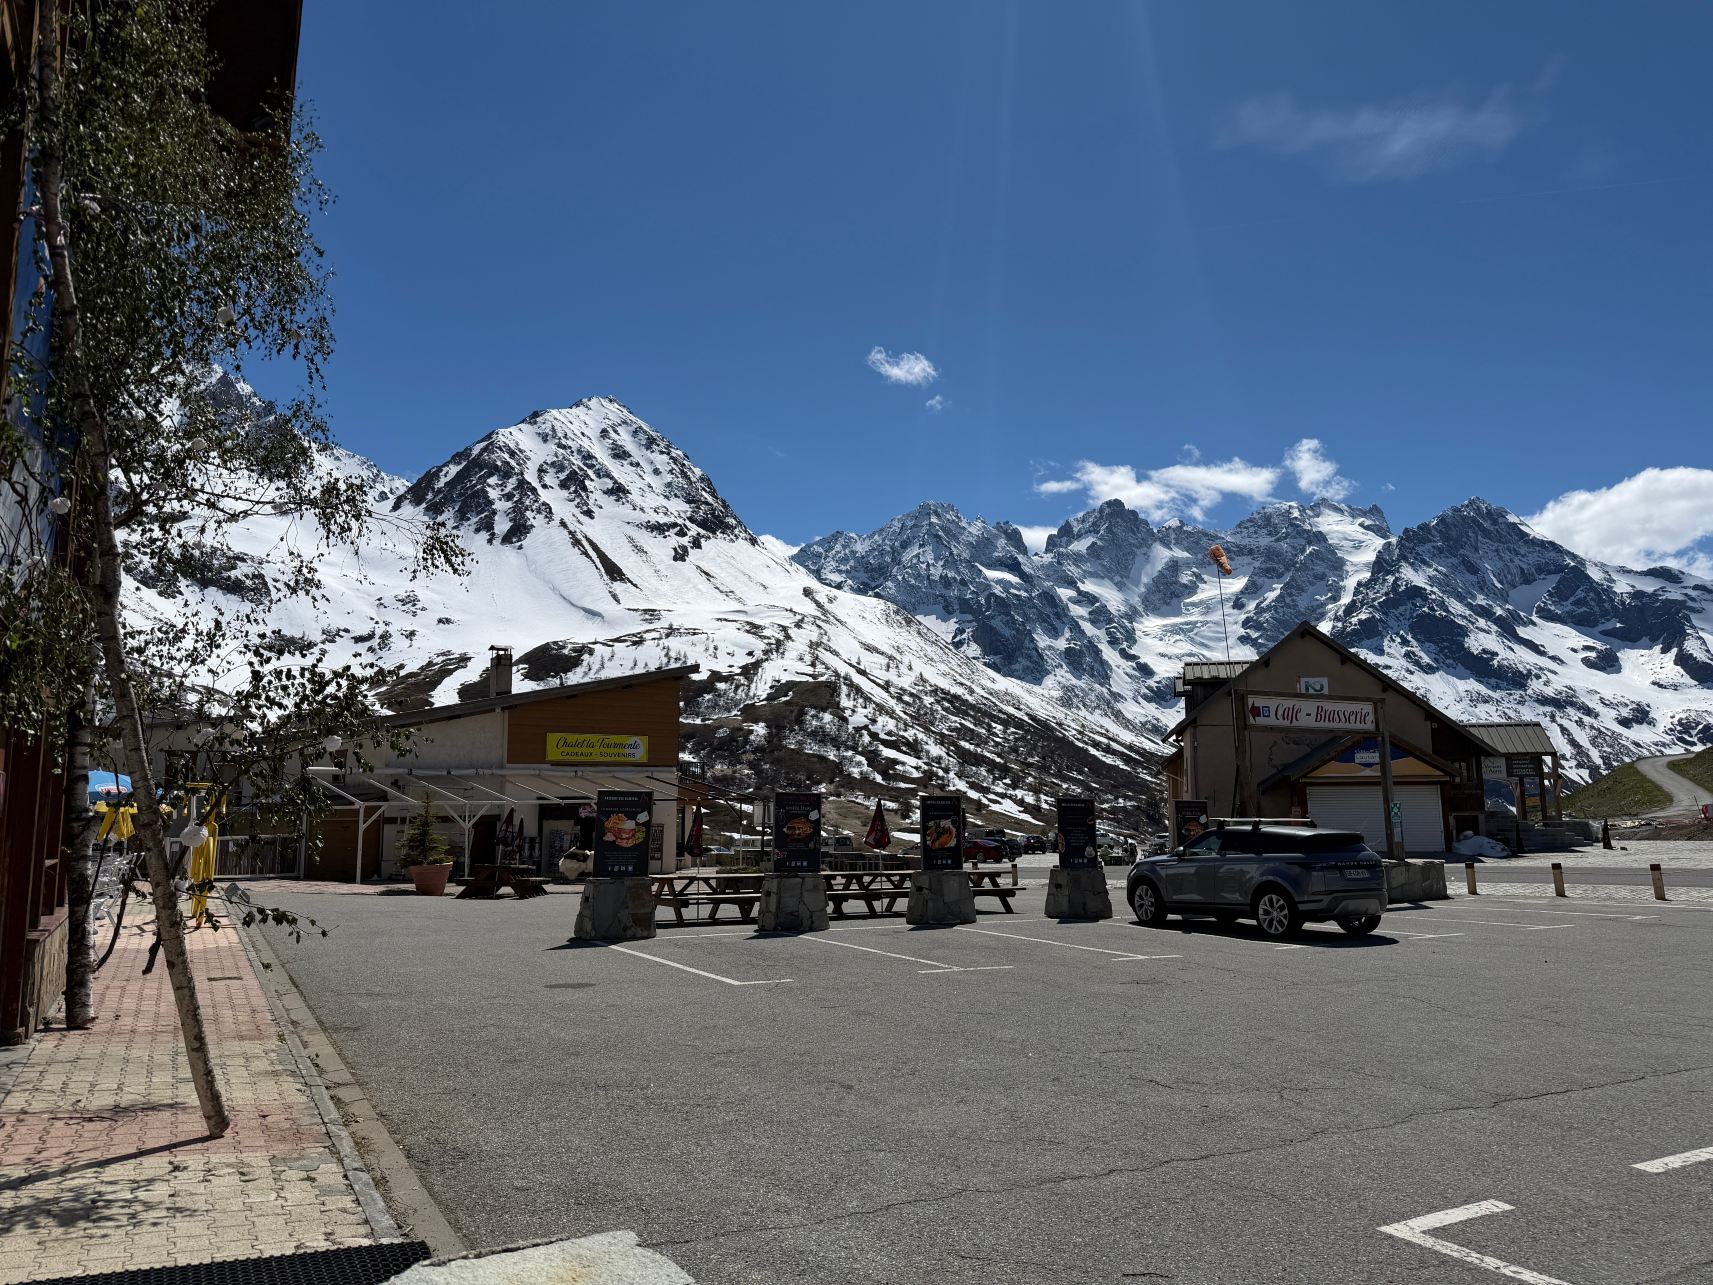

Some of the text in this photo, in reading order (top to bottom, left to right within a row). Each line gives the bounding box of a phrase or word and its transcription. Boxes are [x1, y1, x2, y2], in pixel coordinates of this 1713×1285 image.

[556, 736, 587, 750] Chalet
[597, 737, 641, 750] Tourmente
[560, 750, 593, 758] CADEAUX
[599, 751, 636, 759] SOUVENIRS
